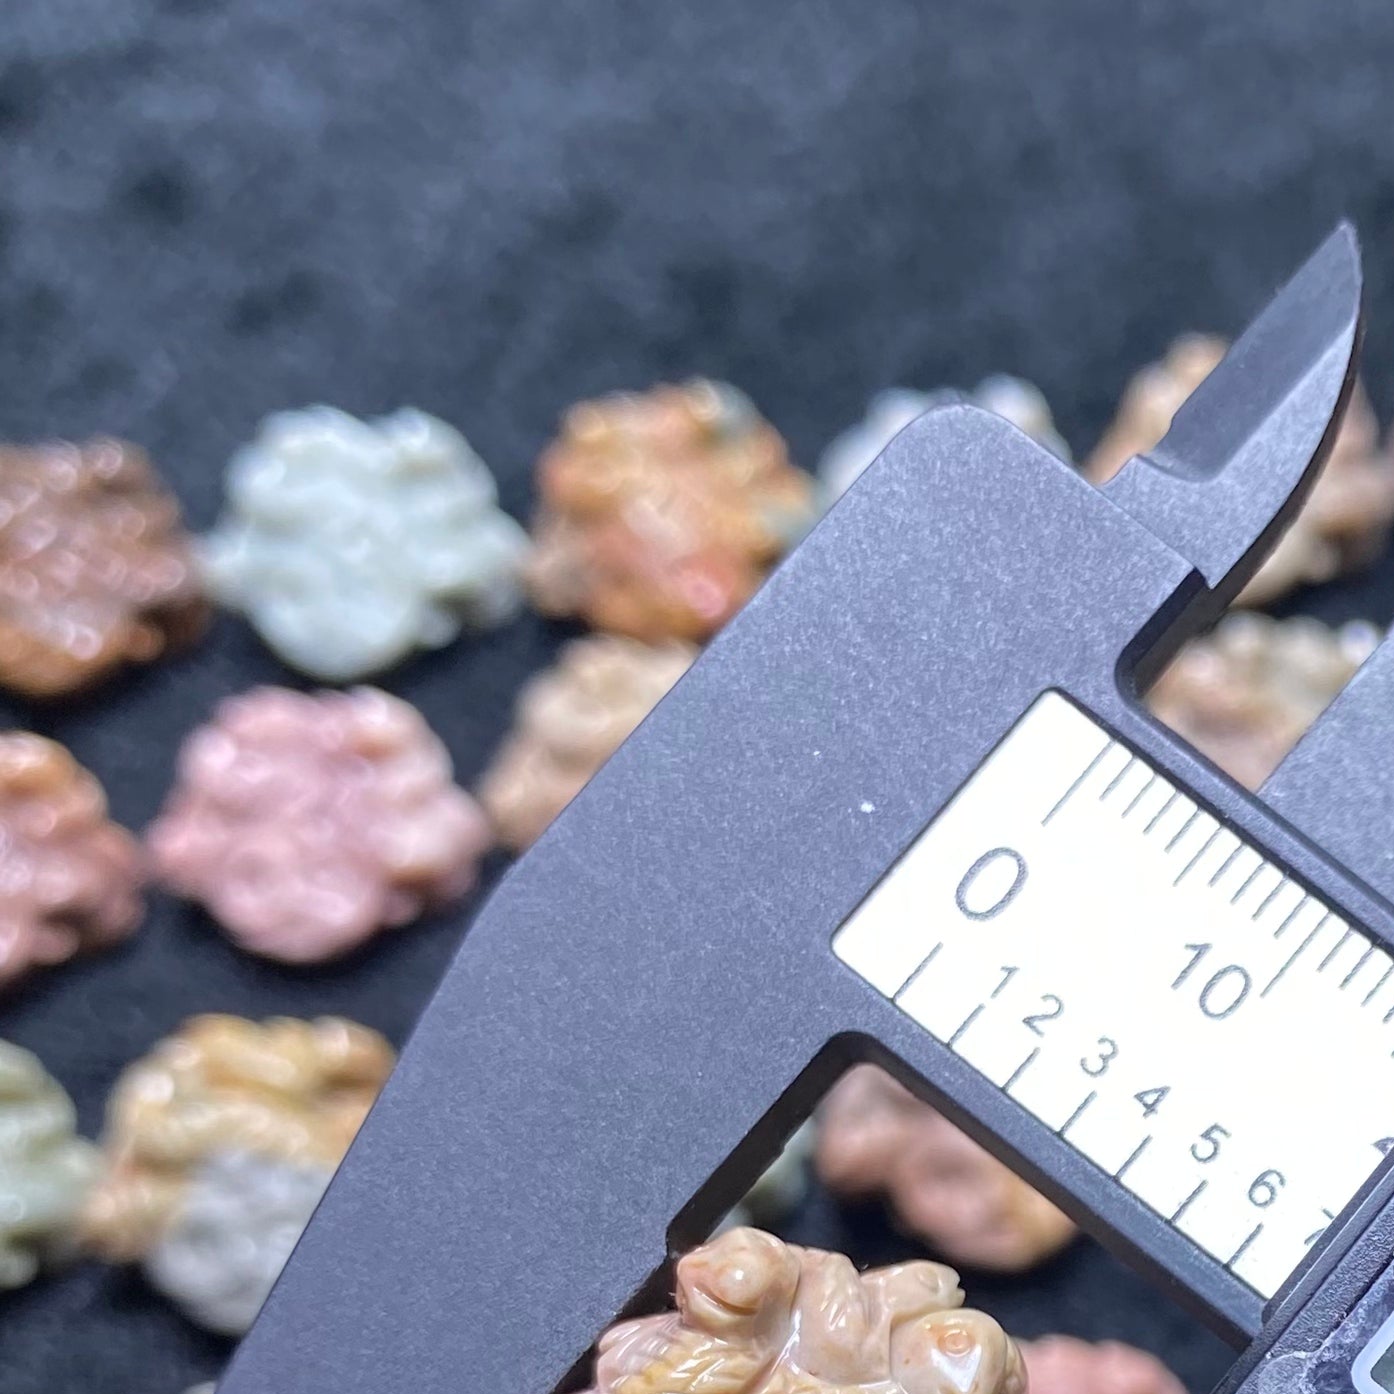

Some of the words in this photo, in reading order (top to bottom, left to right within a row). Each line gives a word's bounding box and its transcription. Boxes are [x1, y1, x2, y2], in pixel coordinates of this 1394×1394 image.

[955, 847, 1027, 921] 0
[1171, 942, 1252, 1020] 10
[991, 966, 1019, 997] 1
[1022, 994, 1064, 1036] 2
[1080, 1037, 1118, 1077] 3
[1133, 1085, 1171, 1118] 4
[1190, 1123, 1231, 1164] 5
[1247, 1169, 1286, 1208] 6
